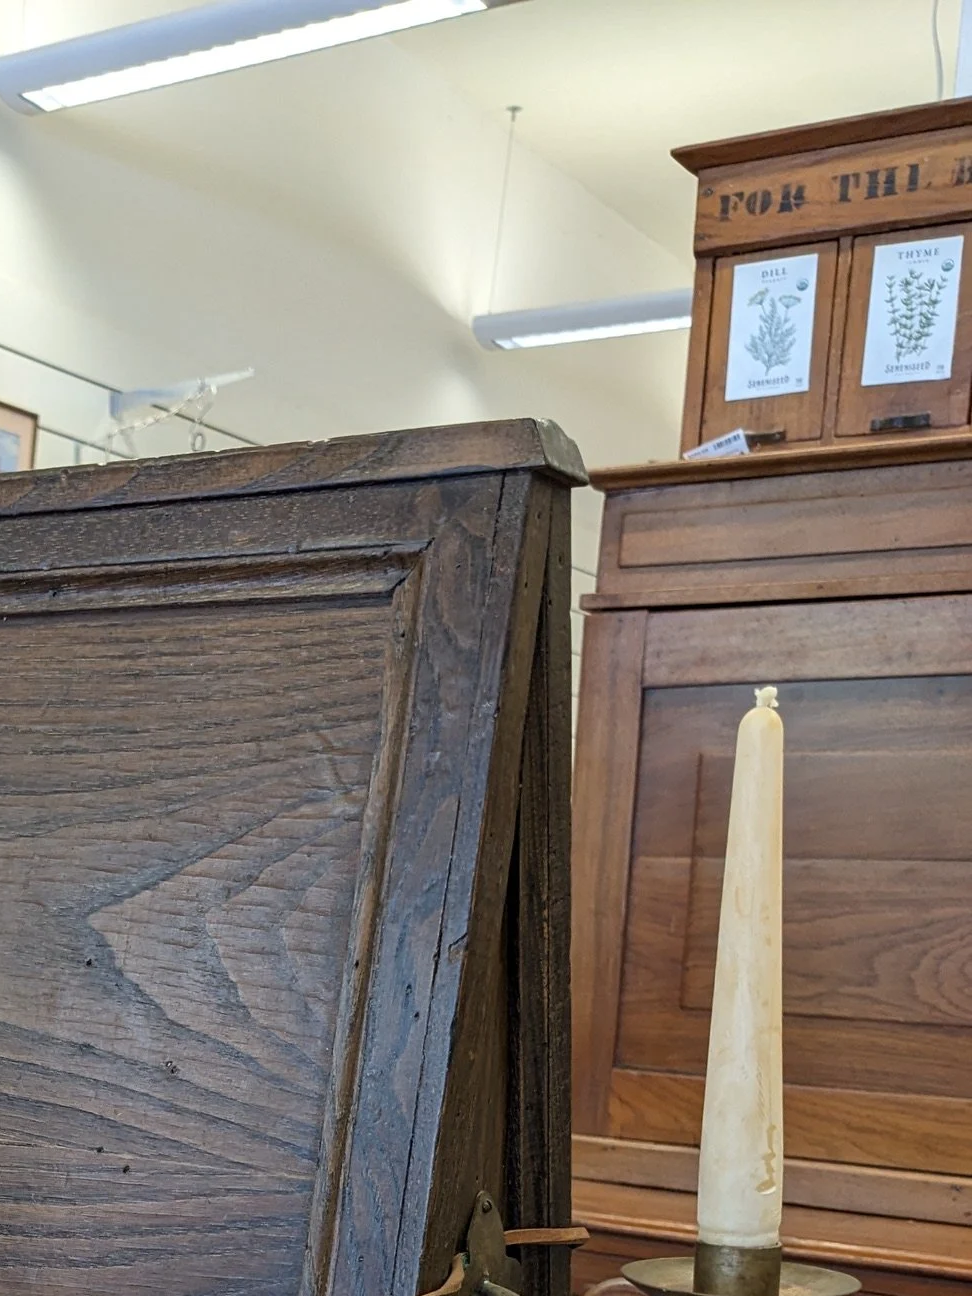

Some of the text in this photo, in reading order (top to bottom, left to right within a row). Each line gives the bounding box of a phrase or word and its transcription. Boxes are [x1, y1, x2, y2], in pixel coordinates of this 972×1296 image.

[719, 184, 806, 221] FOR
[897, 247, 940, 260] THYME
[761, 267, 788, 279] DILL
